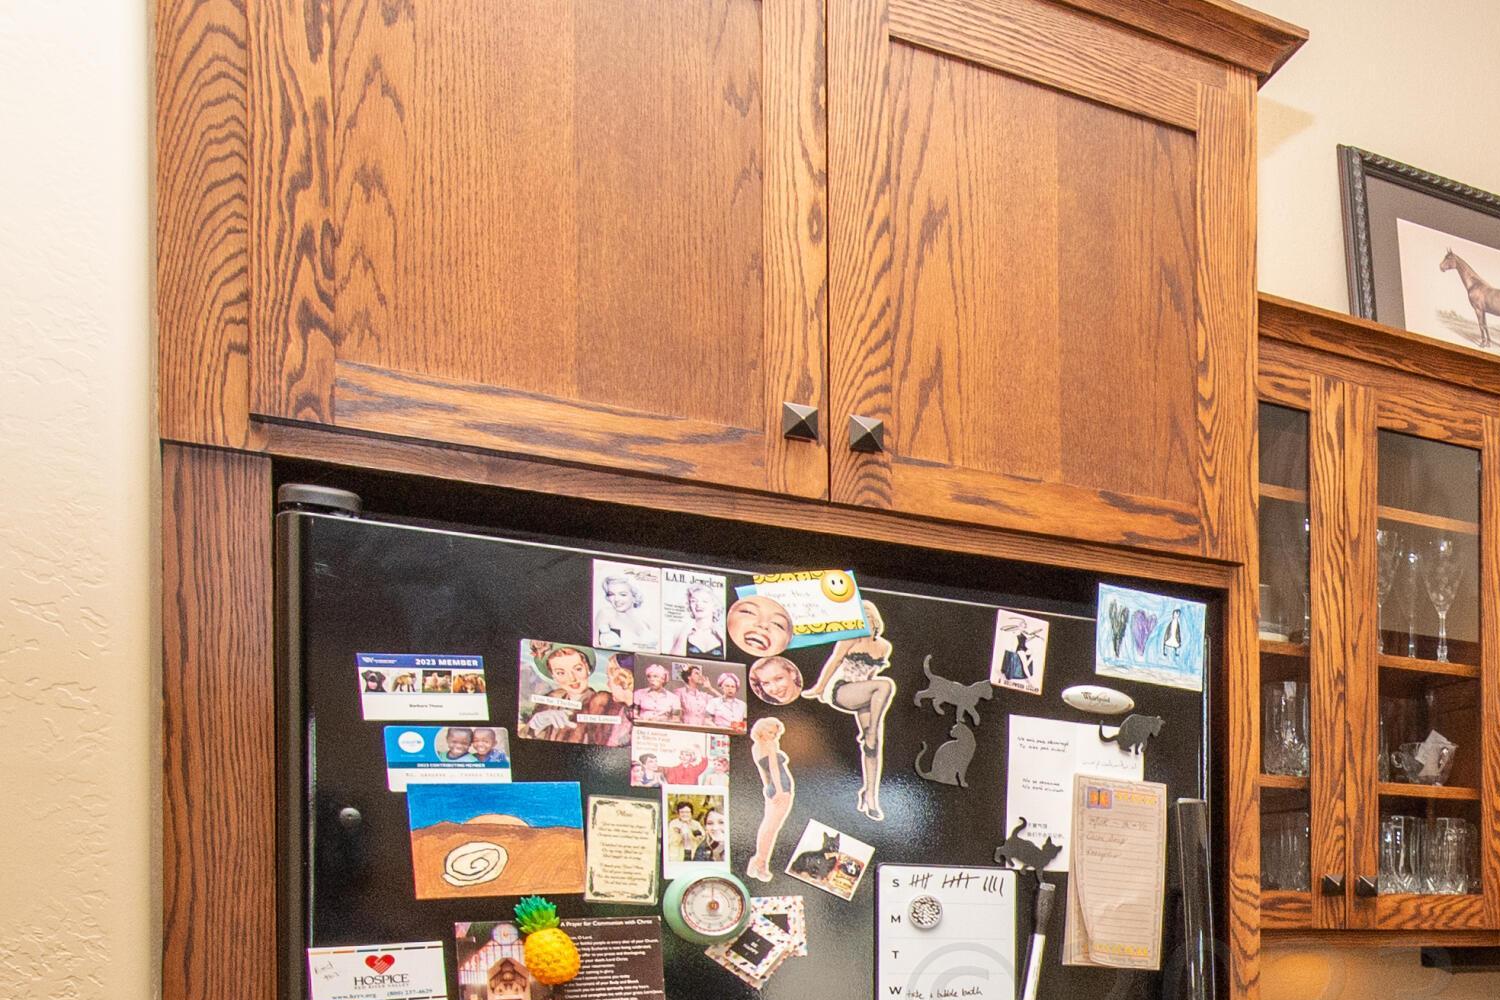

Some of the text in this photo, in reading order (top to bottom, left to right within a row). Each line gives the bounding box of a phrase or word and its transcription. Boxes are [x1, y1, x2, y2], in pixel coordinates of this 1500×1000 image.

[415, 658, 479, 667] 2023 MEMBER
[892, 878, 900, 888] S
[890, 915, 901, 923] M
[892, 950, 900, 959] T
[353, 973, 410, 986] HOSPICE
[889, 986, 902, 995] W
